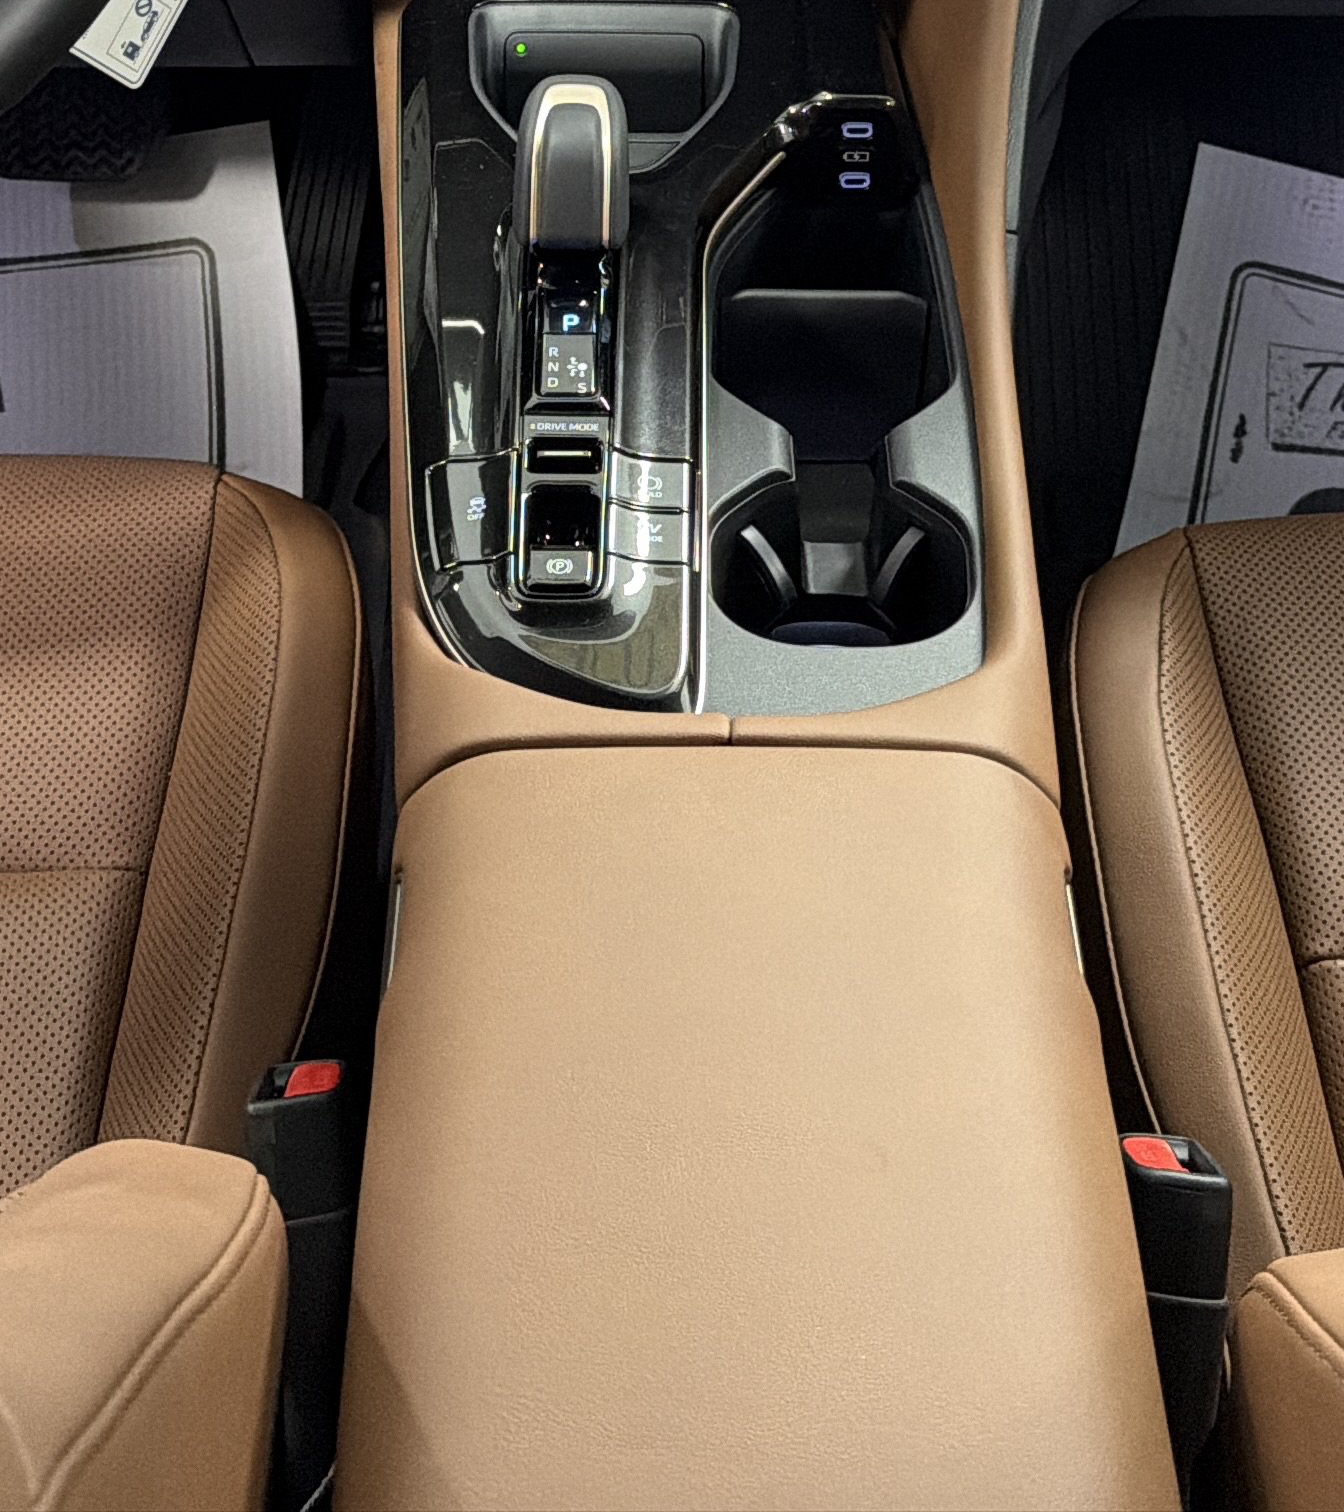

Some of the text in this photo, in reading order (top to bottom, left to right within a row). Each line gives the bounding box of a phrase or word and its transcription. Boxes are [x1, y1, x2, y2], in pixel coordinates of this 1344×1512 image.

[563, 314, 580, 331] P
[548, 347, 559, 357] R
[547, 362, 559, 372] N
[547, 377, 558, 388] D
[577, 382, 587, 393] S
[536, 423, 599, 432] DRIVE MODE
